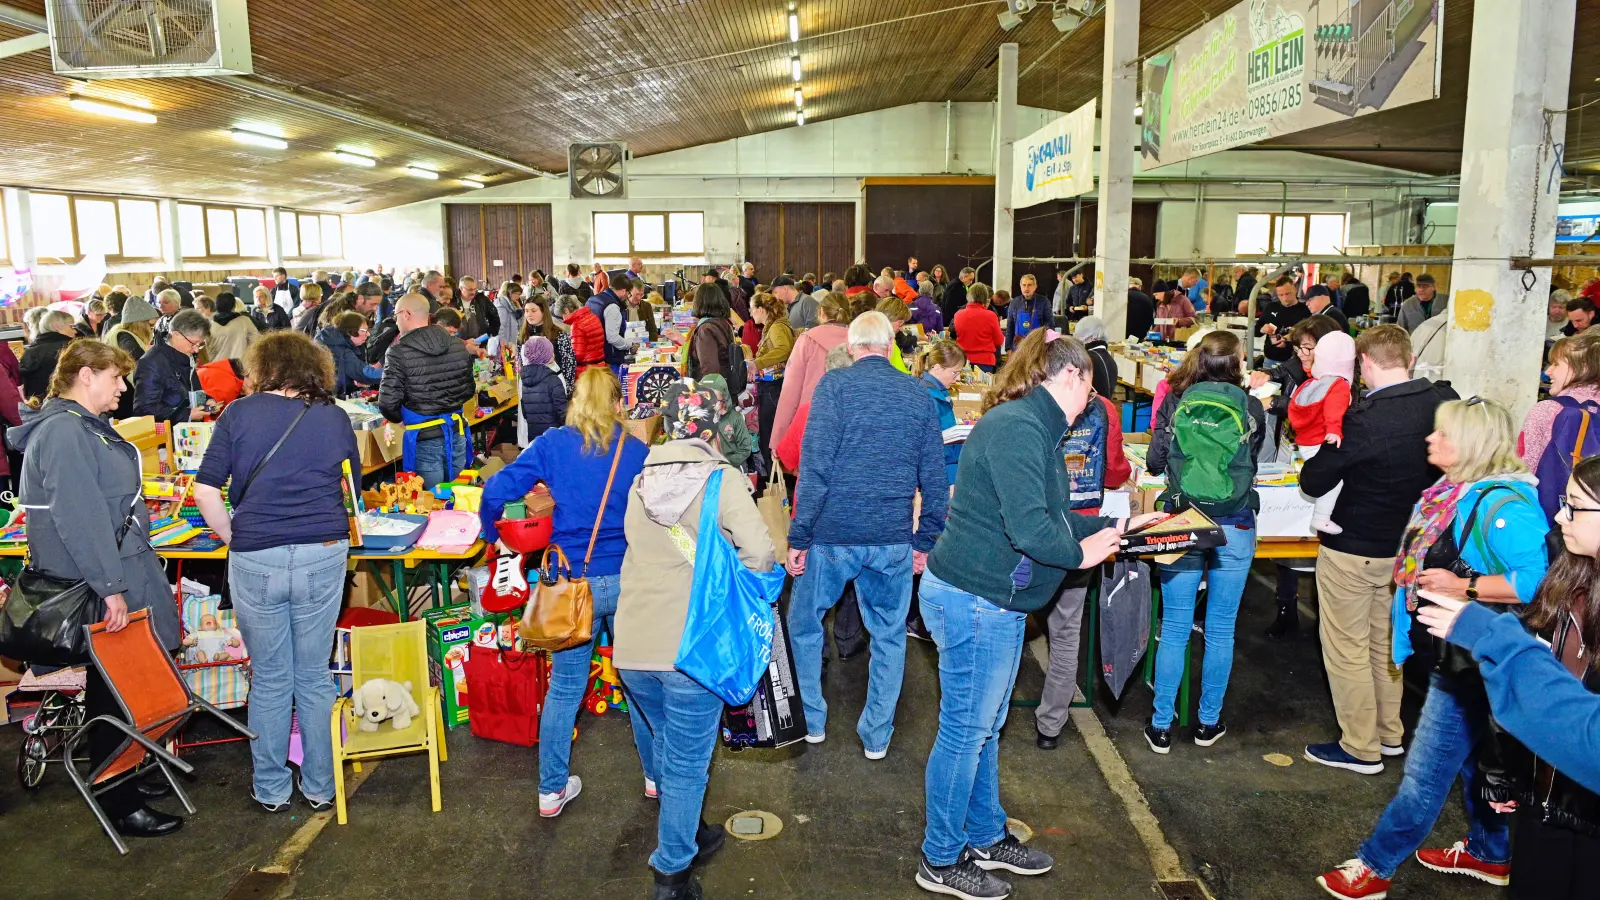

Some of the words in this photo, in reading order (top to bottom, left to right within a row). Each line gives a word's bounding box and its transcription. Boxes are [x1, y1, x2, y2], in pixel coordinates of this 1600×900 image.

[1248, 30, 1304, 86] HERTLEIN
[1172, 110, 1239, 142] www.hertlein24.de
[1248, 83, 1301, 120] 09856/285
[1145, 534, 1189, 544] Triominos
[444, 630, 469, 642] chicco
